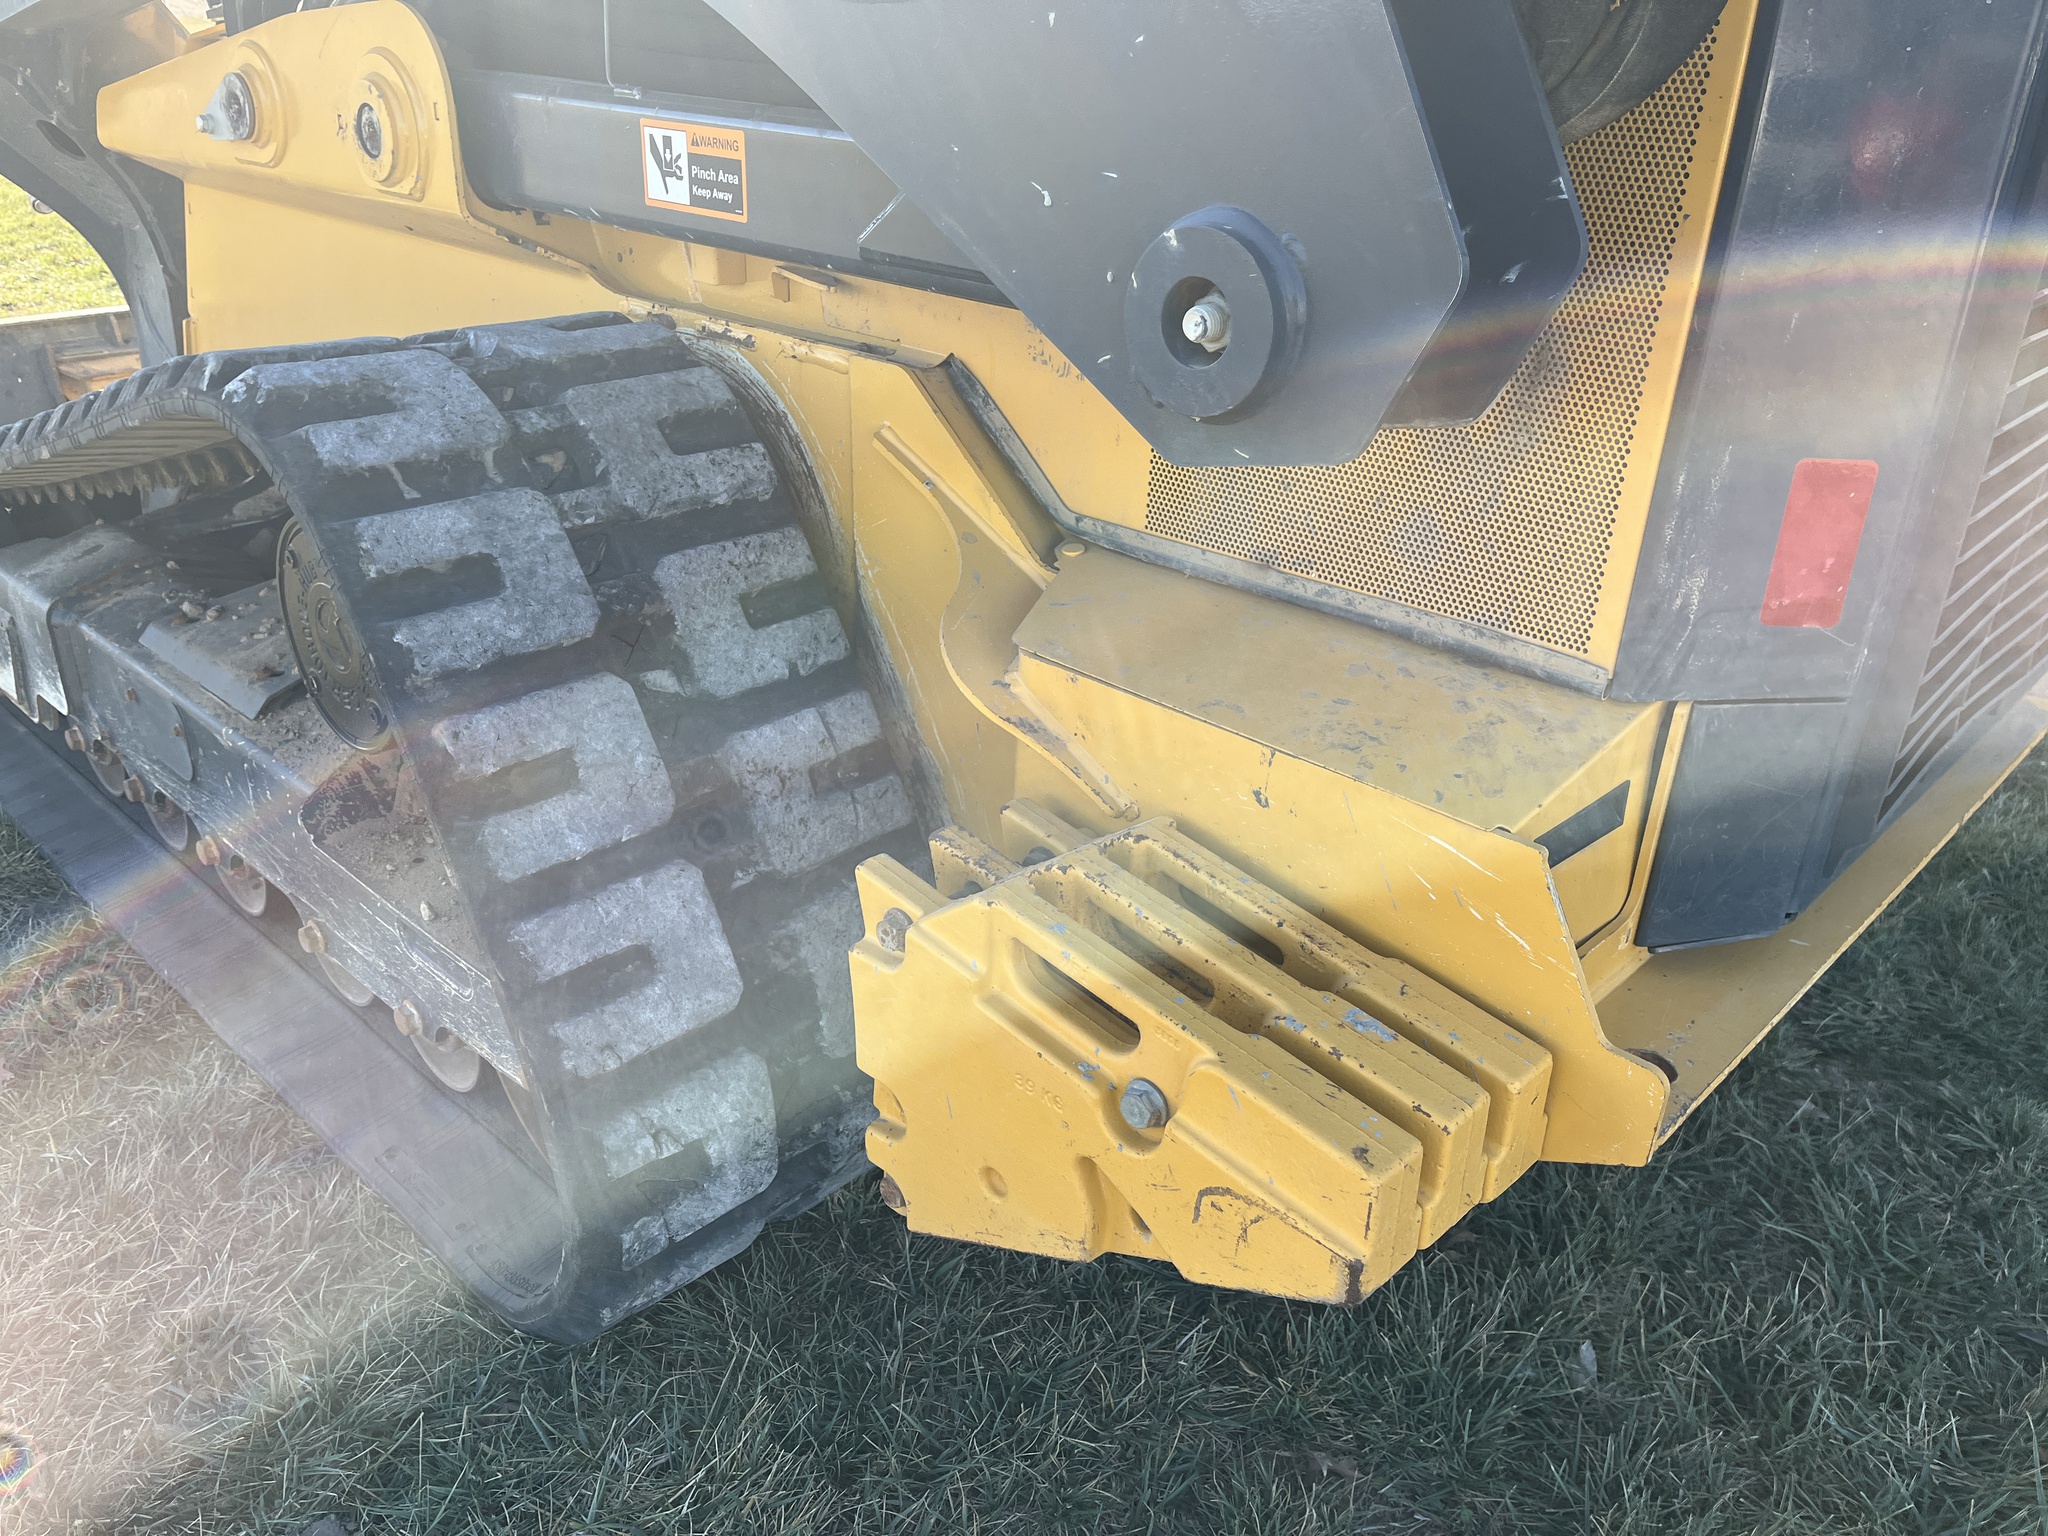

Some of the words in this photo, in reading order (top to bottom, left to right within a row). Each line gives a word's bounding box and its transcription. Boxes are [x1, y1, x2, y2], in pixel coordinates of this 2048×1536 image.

[699, 135, 739, 152] WARNING
[691, 165, 716, 181] Pinch
[718, 169, 739, 185] Area
[692, 184, 711, 200] Keep
[712, 188, 733, 204] Away
